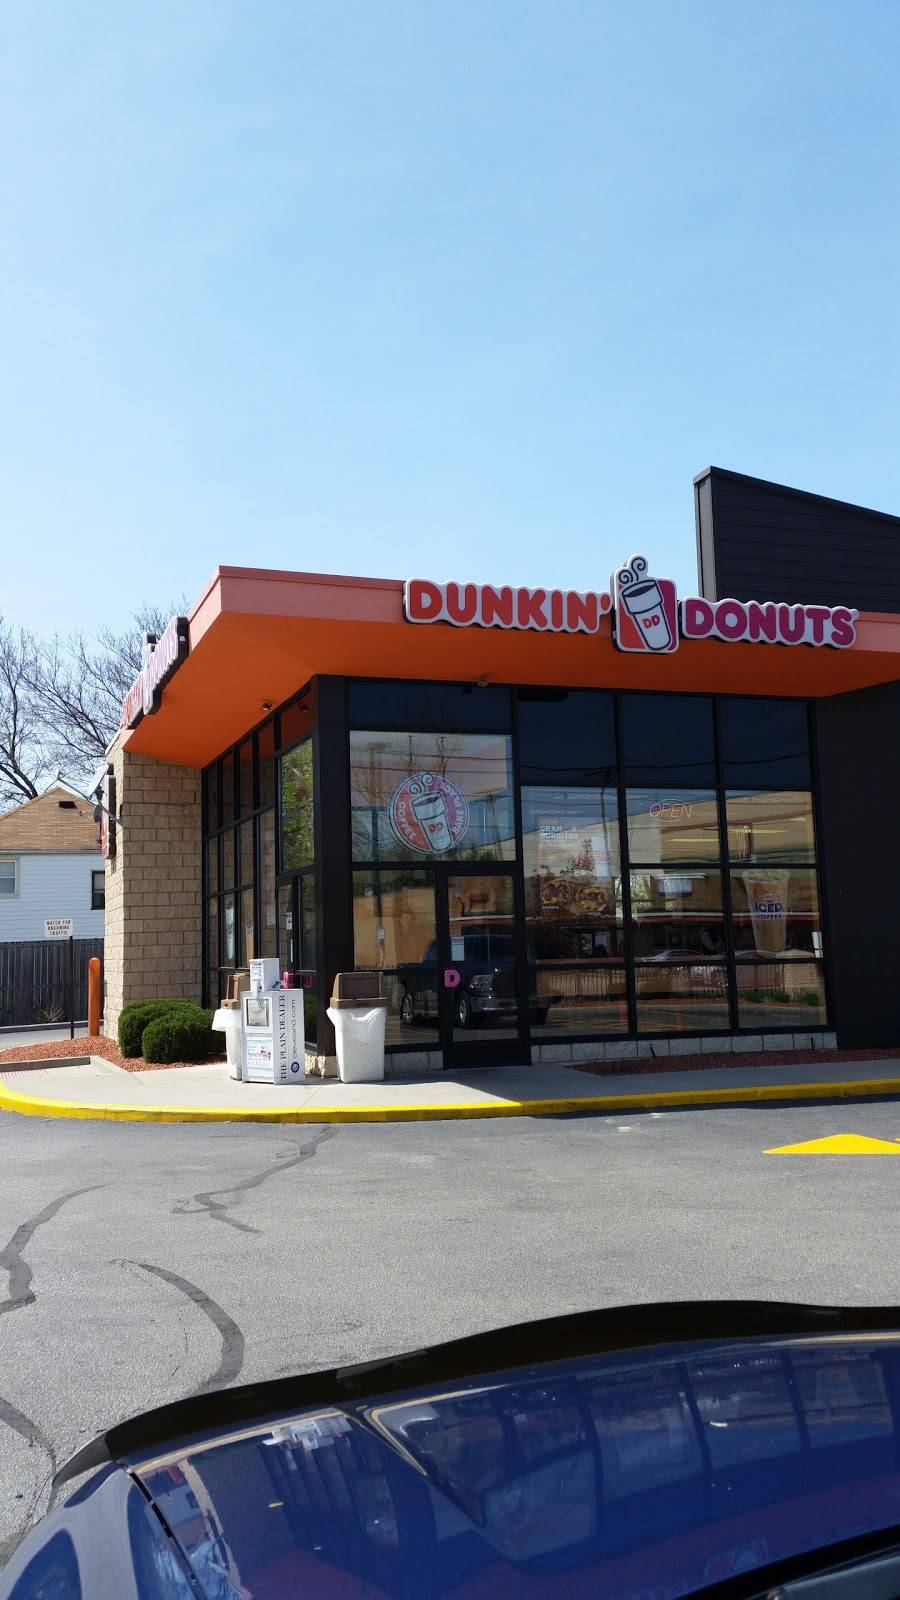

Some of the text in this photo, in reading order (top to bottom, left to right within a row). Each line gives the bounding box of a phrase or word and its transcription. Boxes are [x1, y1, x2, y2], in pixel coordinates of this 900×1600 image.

[409, 580, 855, 646] DUNKIN' DONUTS
[642, 614, 660, 629] DD
[649, 802, 693, 818] OPEN
[754, 901, 783, 913] ICED
[278, 994, 286, 1030] DEALER
[279, 1032, 287, 1060] PLAIN
